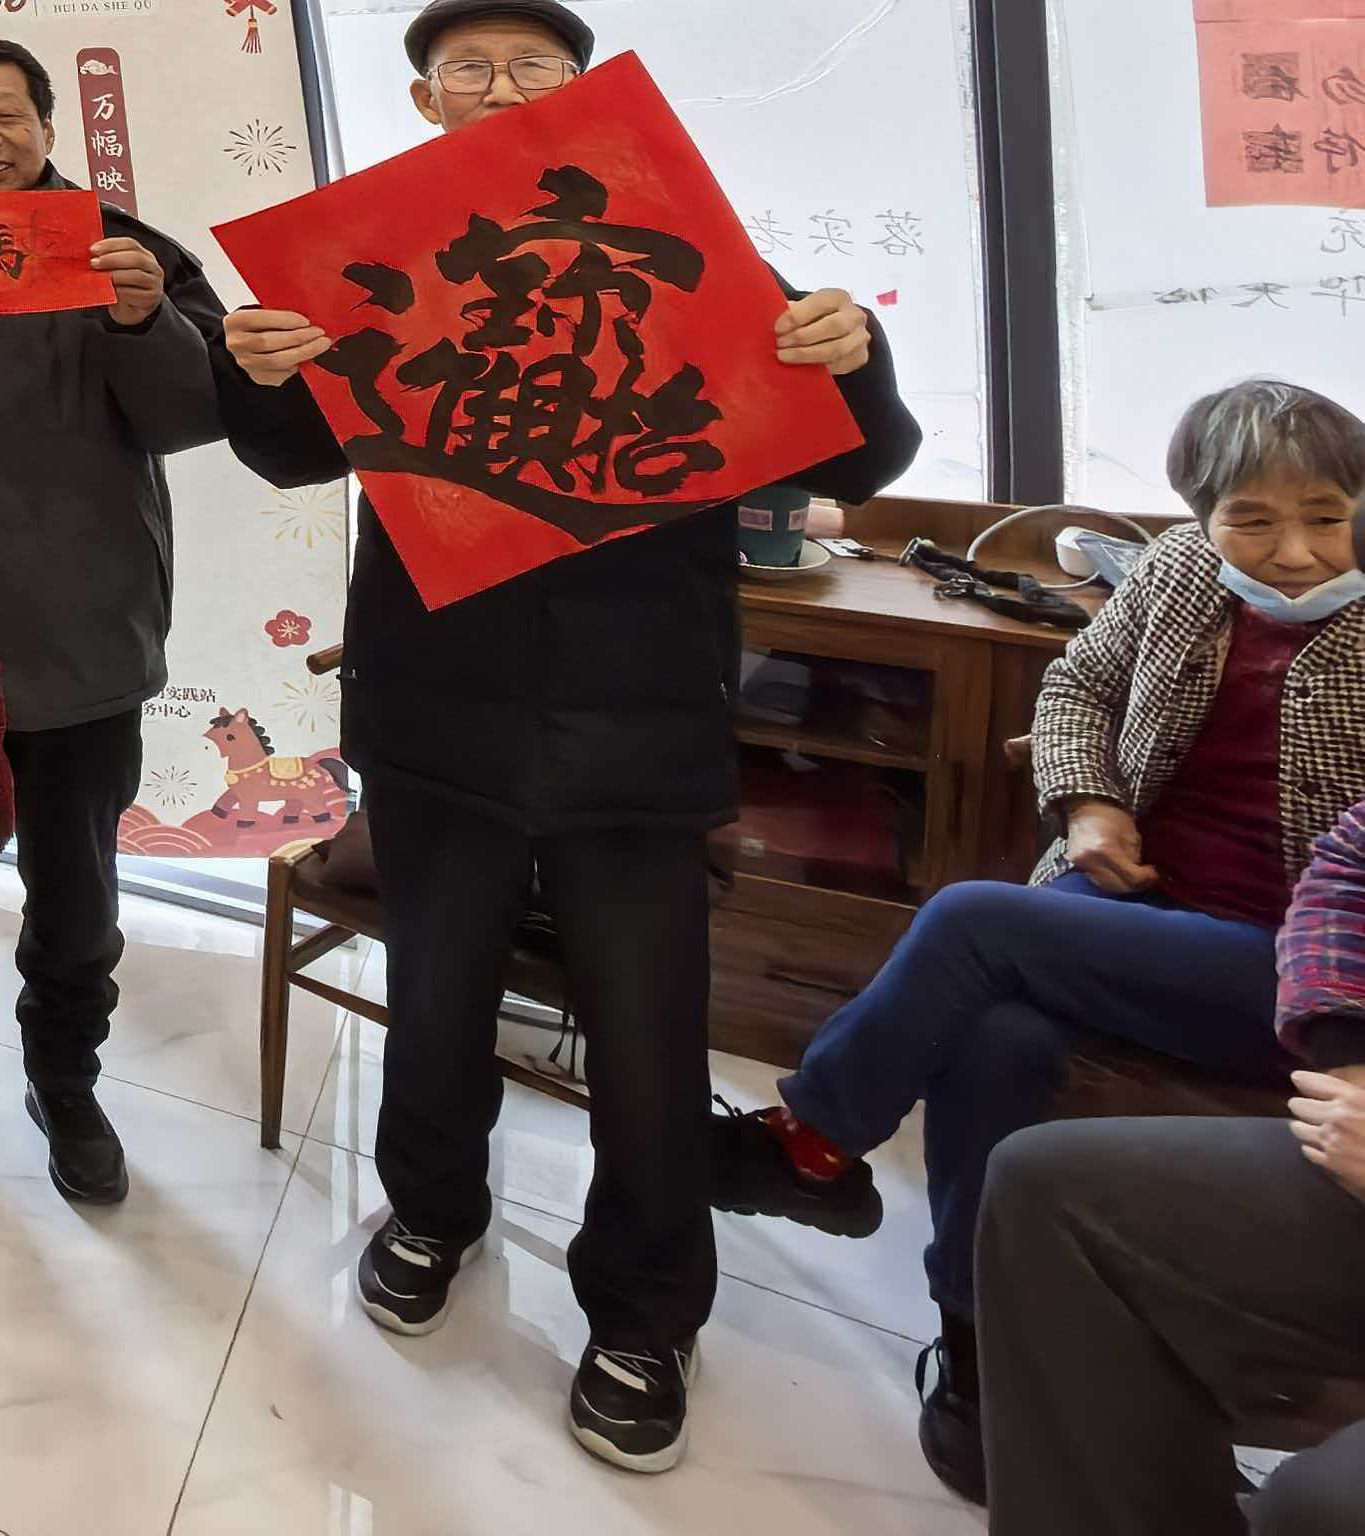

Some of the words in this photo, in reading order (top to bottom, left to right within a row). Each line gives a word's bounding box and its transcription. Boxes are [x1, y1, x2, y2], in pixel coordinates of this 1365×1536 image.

[53, 4, 76, 14] HUI
[81, 2, 99, 13] DA
[103, 0, 127, 12] SHE
[134, 0, 152, 11] QU
[90, 93, 129, 212] 万幅映
[160, 686, 217, 703] 实践站
